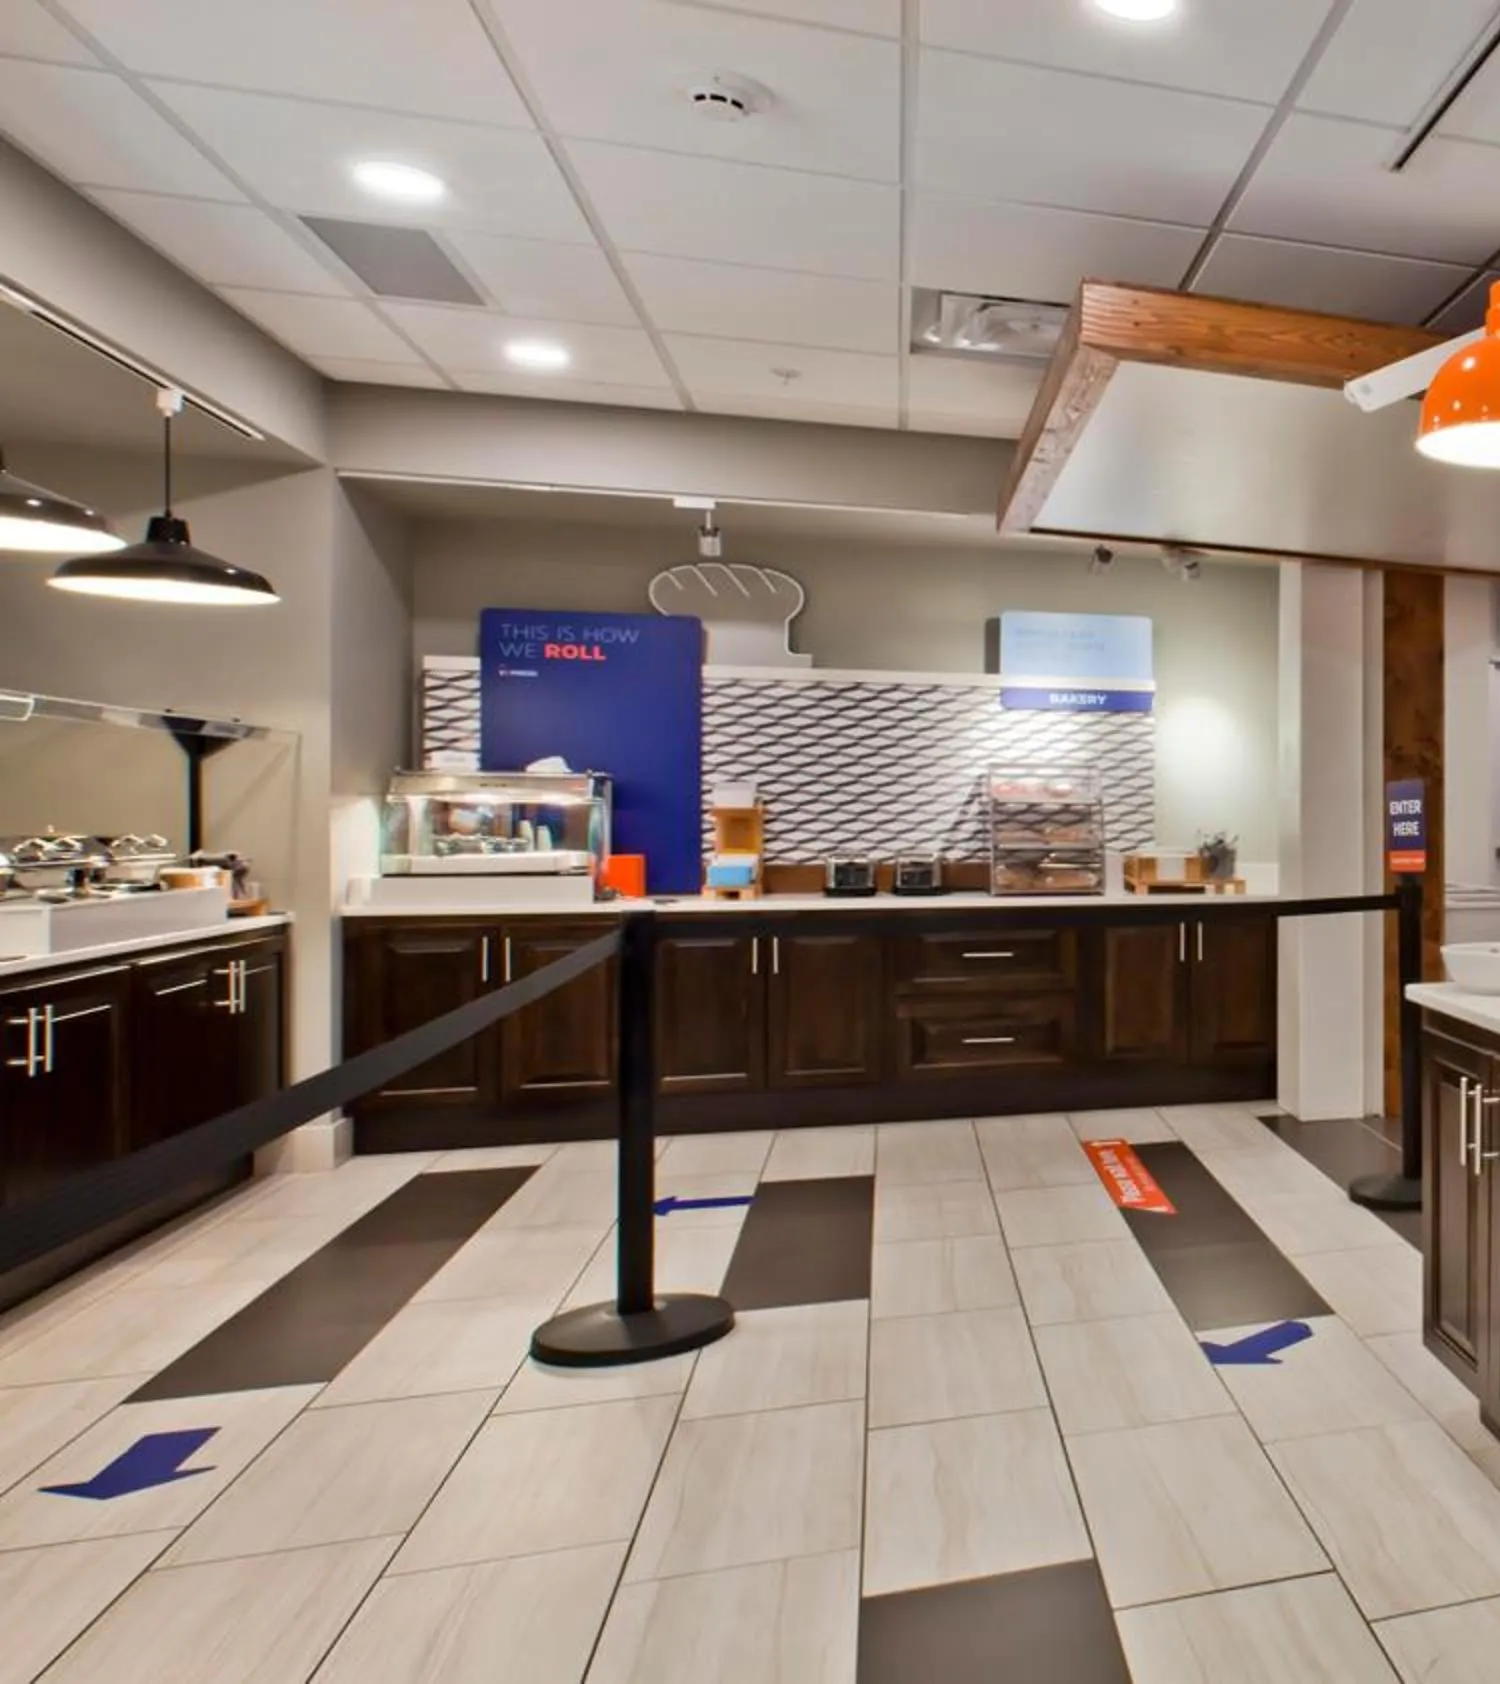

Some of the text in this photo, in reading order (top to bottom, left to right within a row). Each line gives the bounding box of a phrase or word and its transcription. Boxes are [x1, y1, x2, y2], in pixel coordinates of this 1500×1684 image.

[501, 623, 641, 644] THIS IS HOW
[498, 641, 606, 661] WE ROLL
[1049, 692, 1107, 705] BAKERY
[1390, 800, 1421, 815] ENTER
[1393, 821, 1420, 837] HERE
